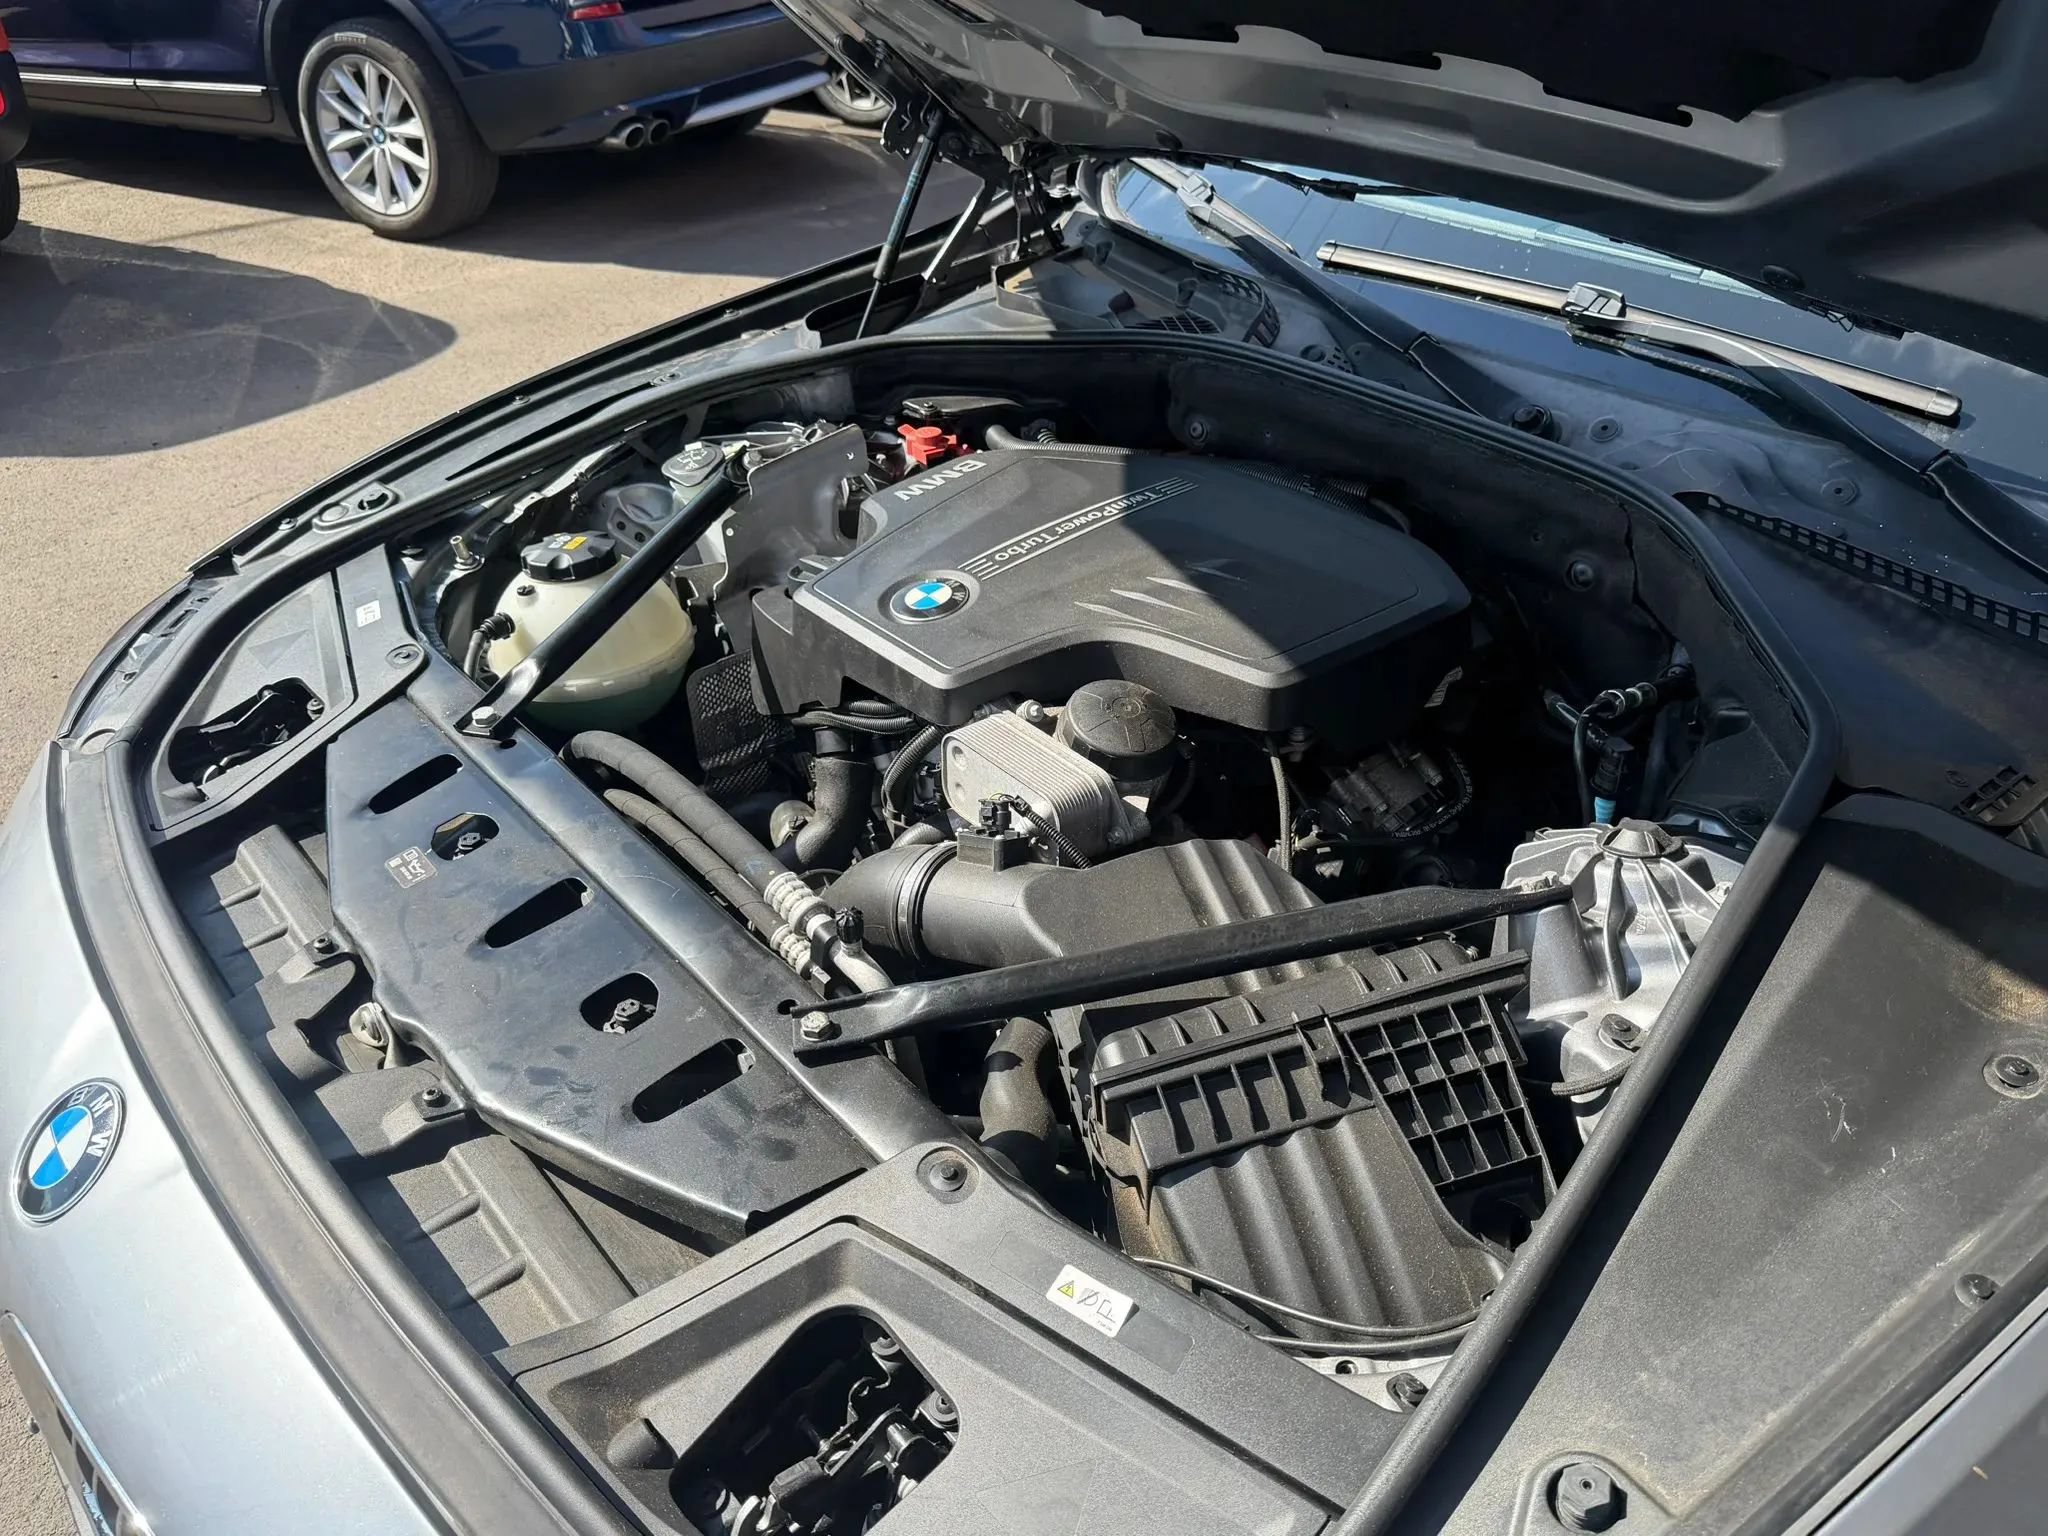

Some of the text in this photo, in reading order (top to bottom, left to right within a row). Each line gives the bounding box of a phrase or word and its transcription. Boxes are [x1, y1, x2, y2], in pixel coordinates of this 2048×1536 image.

[894, 459, 987, 501] BMW
[994, 491, 1164, 561] TwinPower Turbo
[66, 1086, 114, 1158] BMW
